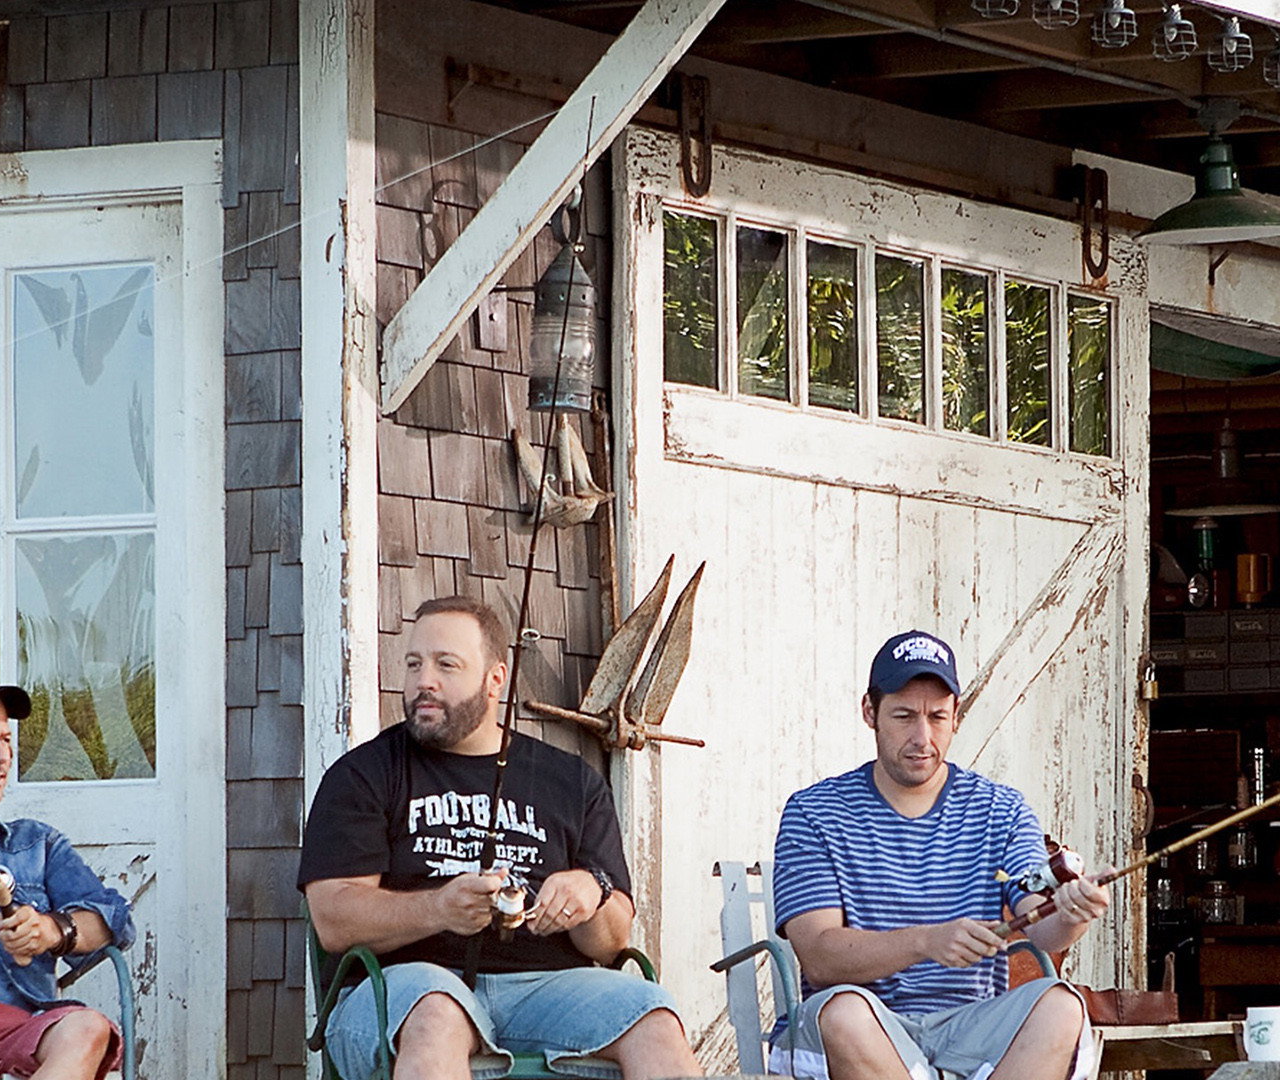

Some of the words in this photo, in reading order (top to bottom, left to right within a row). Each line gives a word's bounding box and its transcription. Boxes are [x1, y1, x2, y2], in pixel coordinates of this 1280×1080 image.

[408, 790, 547, 842] FOOTBALL
[412, 837, 485, 859] ATHLETI
[495, 844, 544, 864] DEPT.
